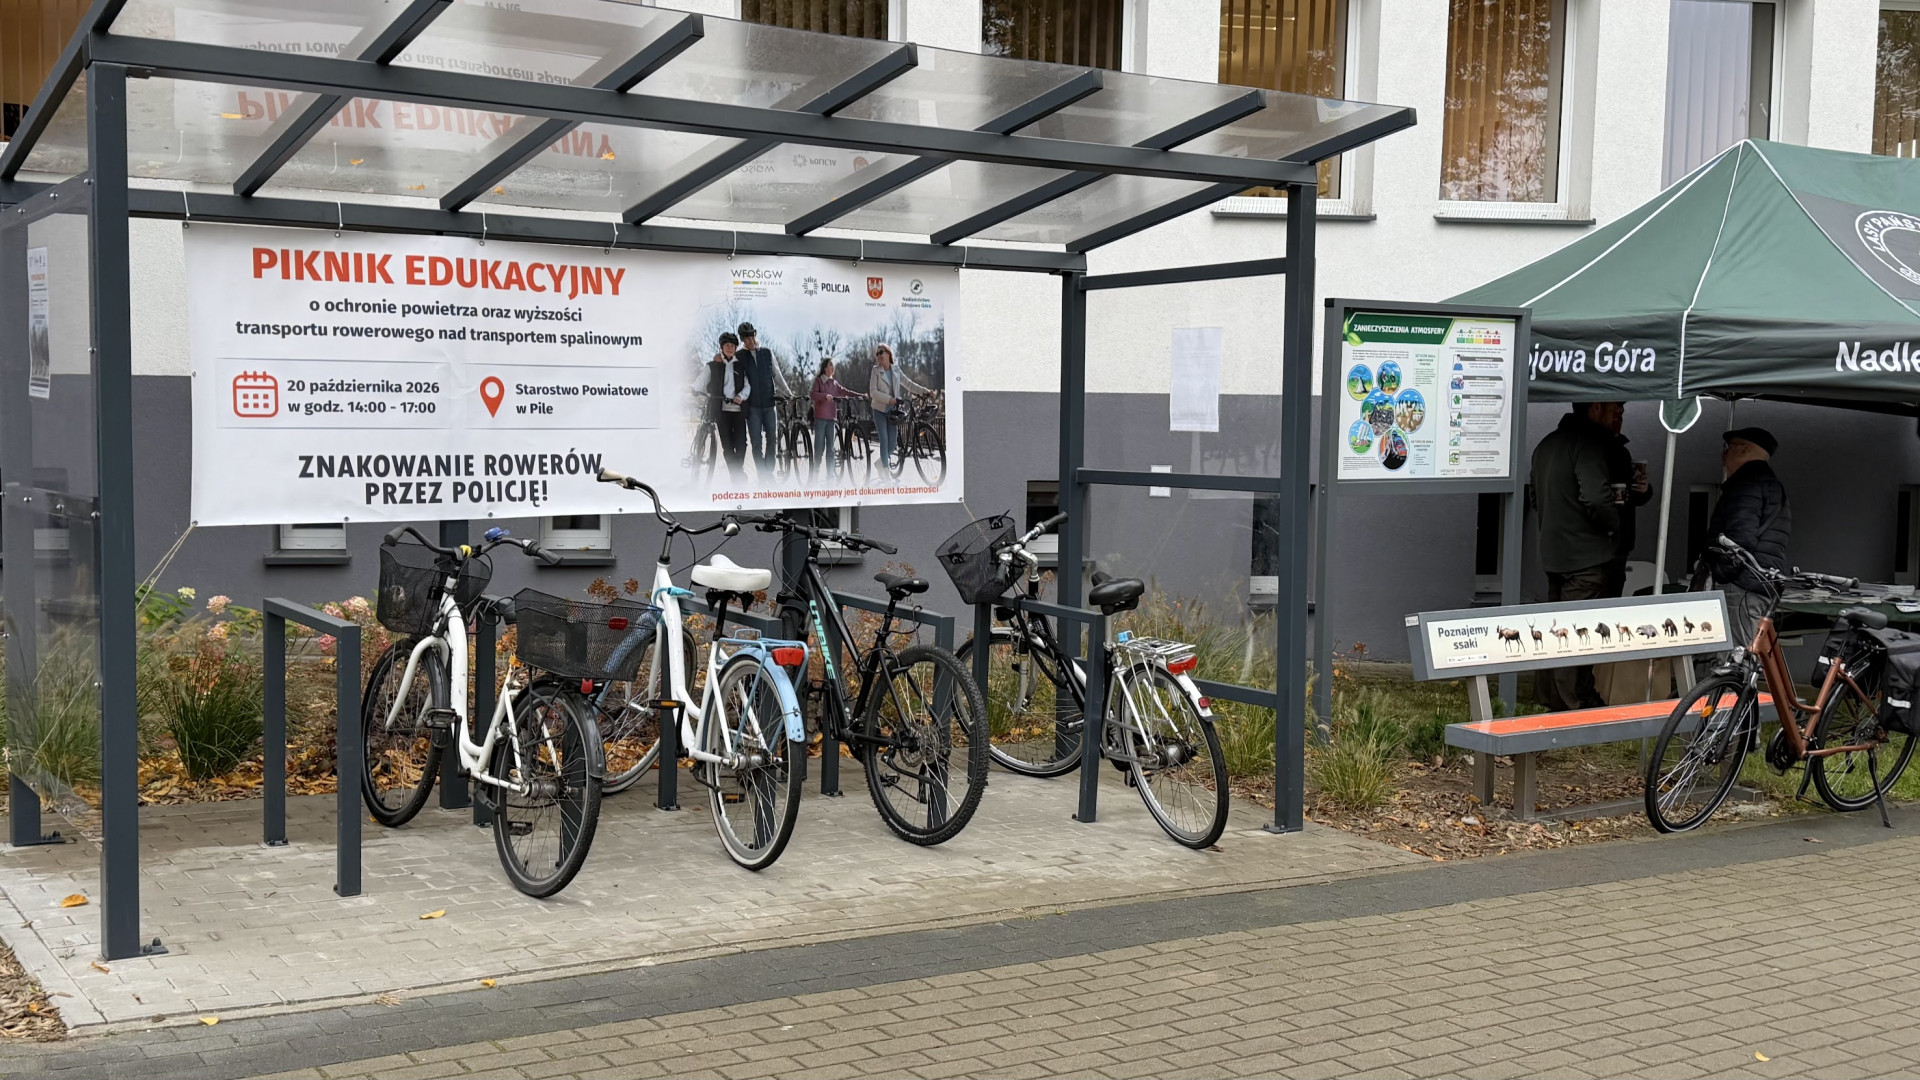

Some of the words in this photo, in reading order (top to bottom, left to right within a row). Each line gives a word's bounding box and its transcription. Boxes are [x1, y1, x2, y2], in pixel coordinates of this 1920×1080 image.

[1863, 220, 1886, 252] LASY
[253, 248, 394, 283] PIKNIK
[406, 255, 625, 300] EDUKACYJNY
[731, 268, 783, 279] WFOŚiGW
[821, 282, 850, 293] POLICJA
[310, 301, 320, 311] o
[325, 298, 397, 313] ochronie
[402, 301, 478, 319] powietrza
[482, 308, 510, 318] oraz
[514, 306, 581, 322] wyższości
[236, 320, 328, 338] transportu
[333, 327, 434, 342] rowerowego
[439, 327, 466, 340] nad
[470, 329, 556, 345] transportem
[560, 331, 642, 348] spalinowym
[1354, 324, 1409, 334] ZANIECZYSZCZENIA
[1410, 326, 1444, 335] ATMOSFERY
[1529, 343, 1586, 380] jowa
[1594, 340, 1656, 373] Góra
[288, 380, 305, 391] 20
[310, 379, 402, 394] października
[406, 382, 439, 393] 2026
[516, 384, 579, 395] Starostwo
[583, 384, 648, 395] Powiatowe
[288, 403, 300, 412] w
[305, 400, 343, 415] godz.
[348, 402, 386, 413] 14:00
[400, 402, 435, 413] 17:00
[530, 402, 553, 414] Pile
[299, 455, 474, 478] ZNAKOWANIE
[484, 448, 603, 475] ROWERÓW
[366, 482, 442, 504] PRZEZ
[453, 480, 547, 507] POLICJĘ!
[712, 491, 750, 502] podczas
[753, 490, 801, 499] znakowania
[804, 489, 842, 498] wymagany
[844, 487, 857, 496] jest
[859, 486, 895, 495] dokument
[897, 485, 938, 494] tożsamości
[1438, 625, 1488, 638] Poznajemy
[1453, 638, 1478, 650] ssaki
